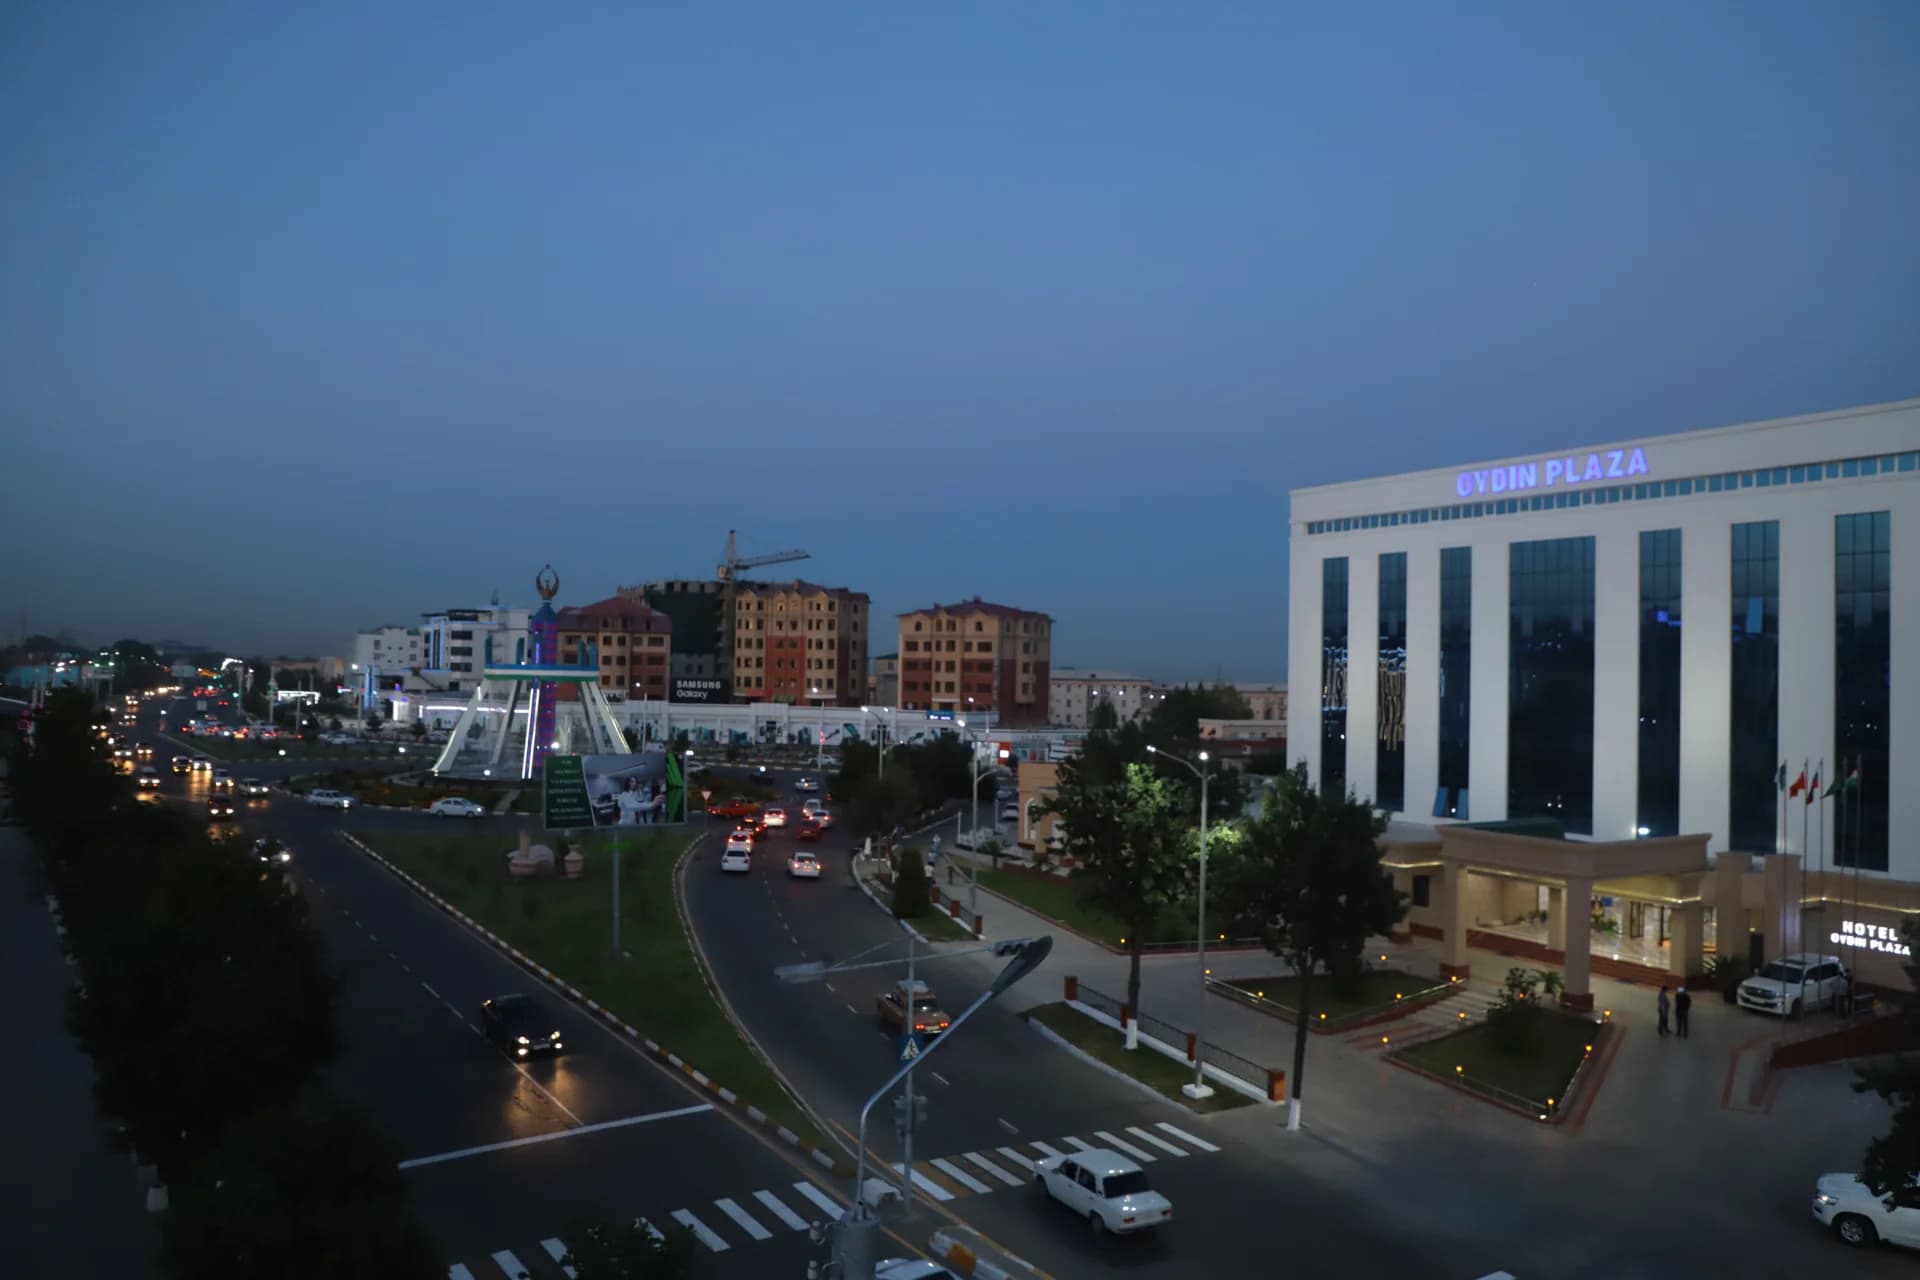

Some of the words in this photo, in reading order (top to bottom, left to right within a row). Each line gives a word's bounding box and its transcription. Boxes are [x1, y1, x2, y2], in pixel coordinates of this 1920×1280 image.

[1456, 462, 1537, 497] OYDIN
[1546, 447, 1649, 486] PLAZA
[676, 680, 721, 689] SAMSUNG
[676, 689, 708, 700] Galaxy
[1842, 920, 1898, 941] HOTEL
[1869, 939, 1911, 956] PLAZA
